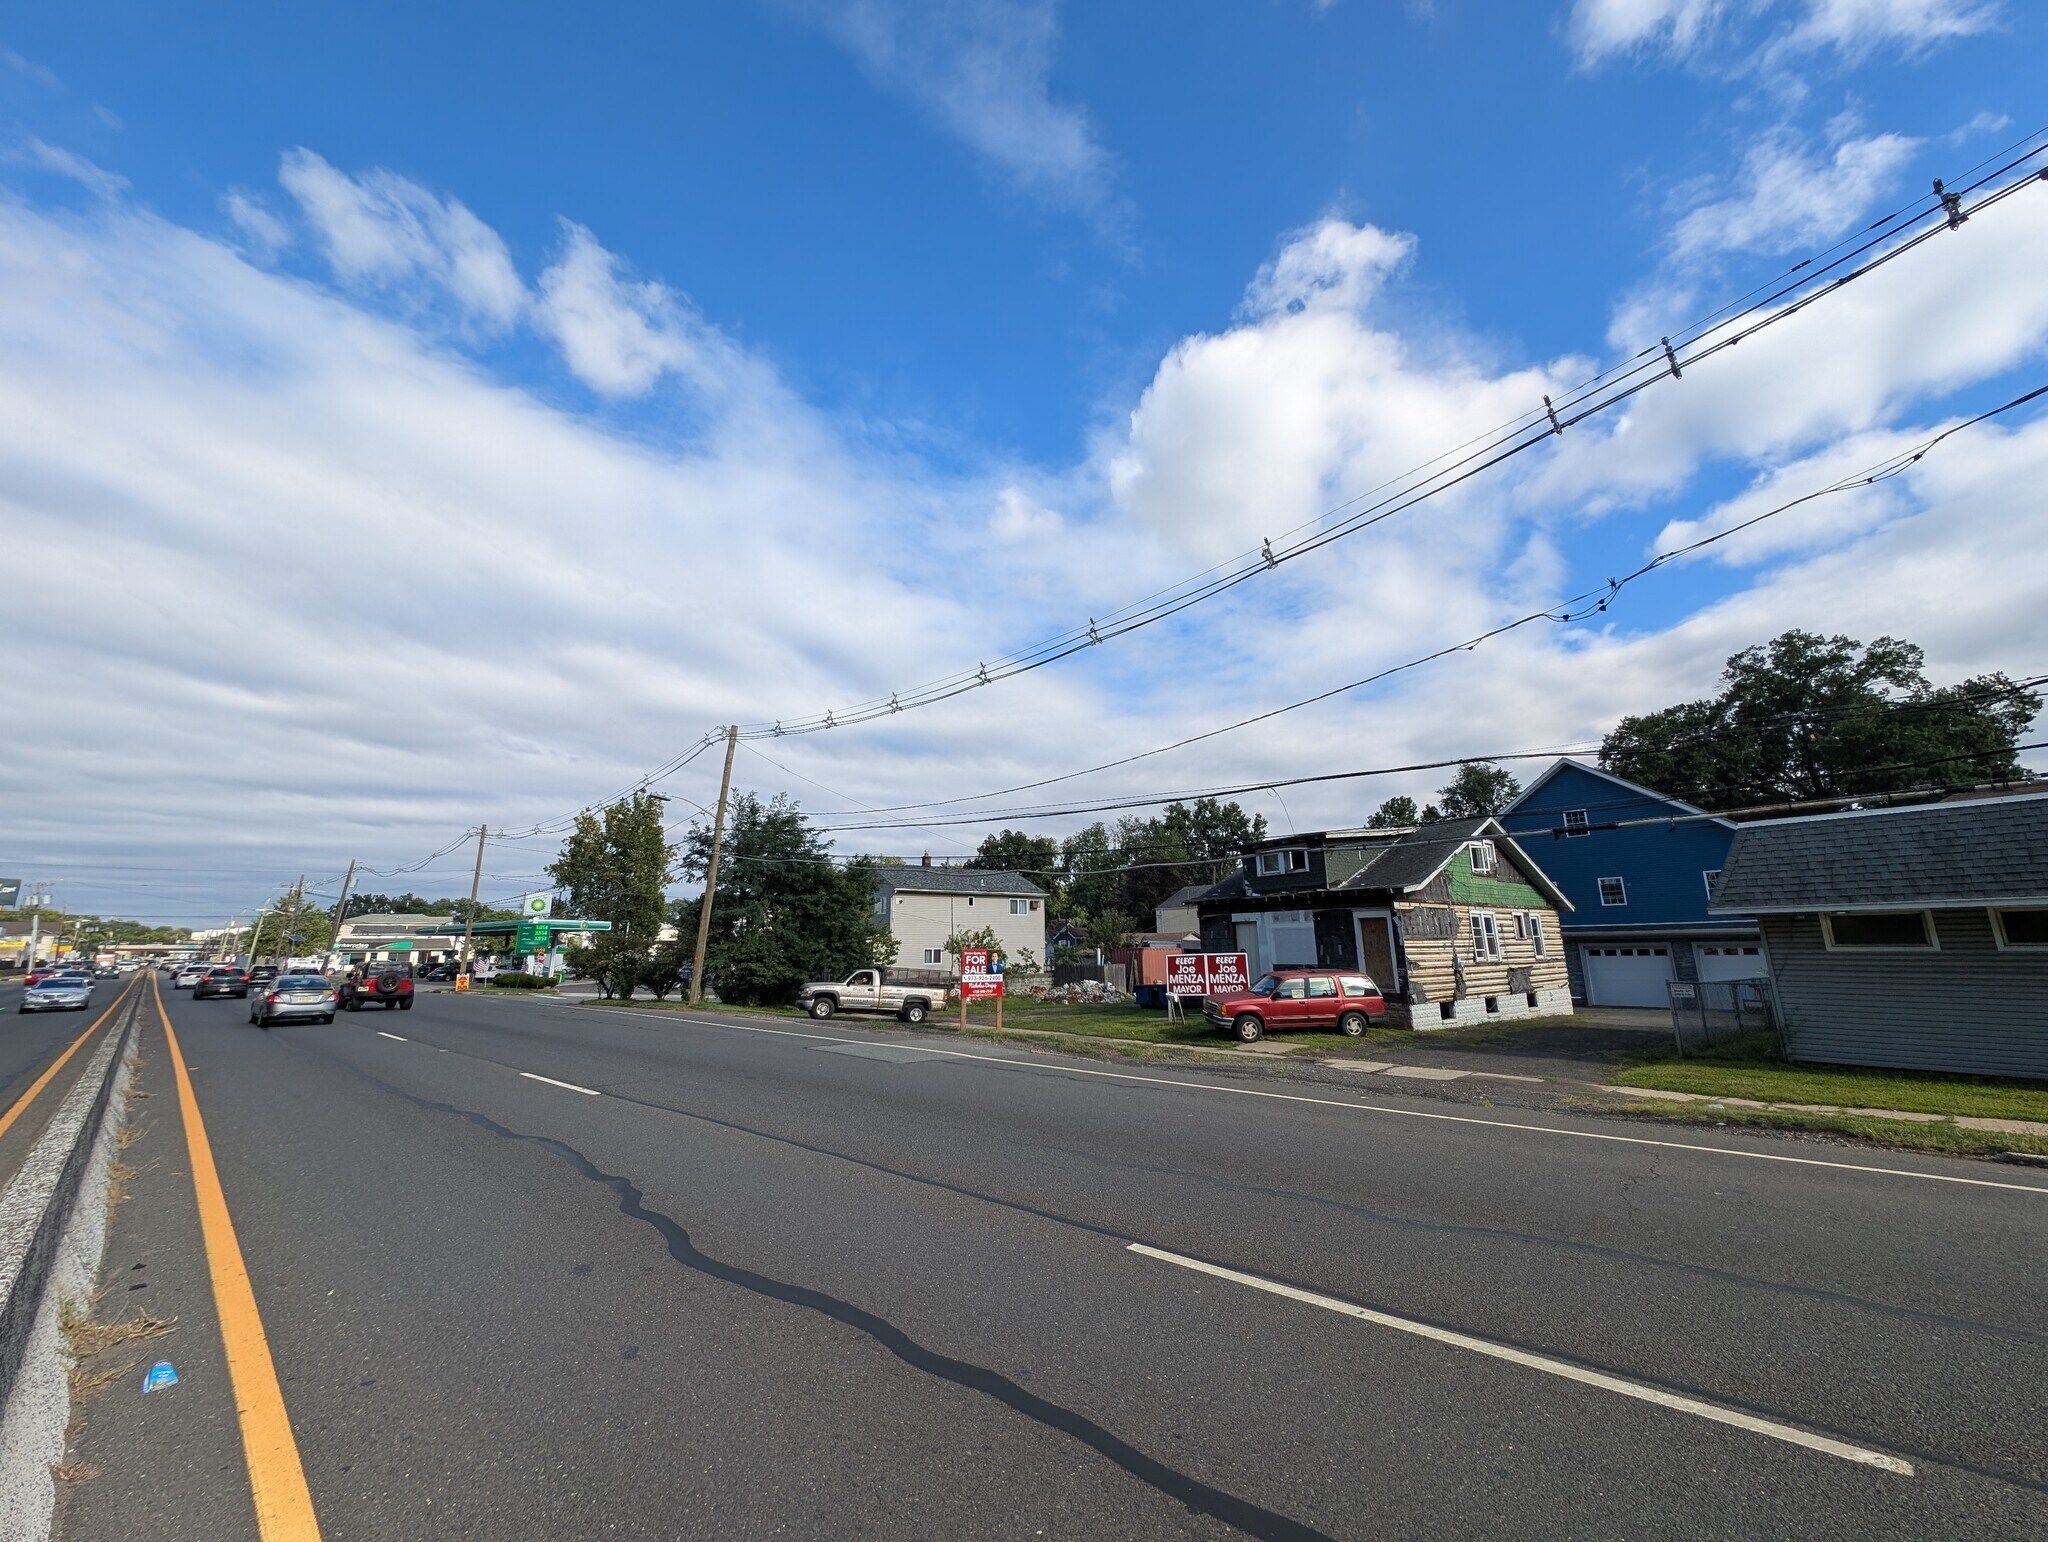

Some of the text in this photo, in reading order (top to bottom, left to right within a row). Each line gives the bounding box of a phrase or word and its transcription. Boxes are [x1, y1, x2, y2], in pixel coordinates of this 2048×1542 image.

[966, 956, 986, 964] FOR
[1215, 956, 1237, 964] ELECT
[965, 966, 986, 974] SALE
[1177, 965, 1196, 974] Joe
[1217, 964, 1237, 973] Joe
[1169, 974, 1205, 984] MENZA
[1210, 973, 1246, 984] MENZA
[1173, 985, 1202, 993] MAYOR
[1214, 985, 1243, 993] MAYOR
